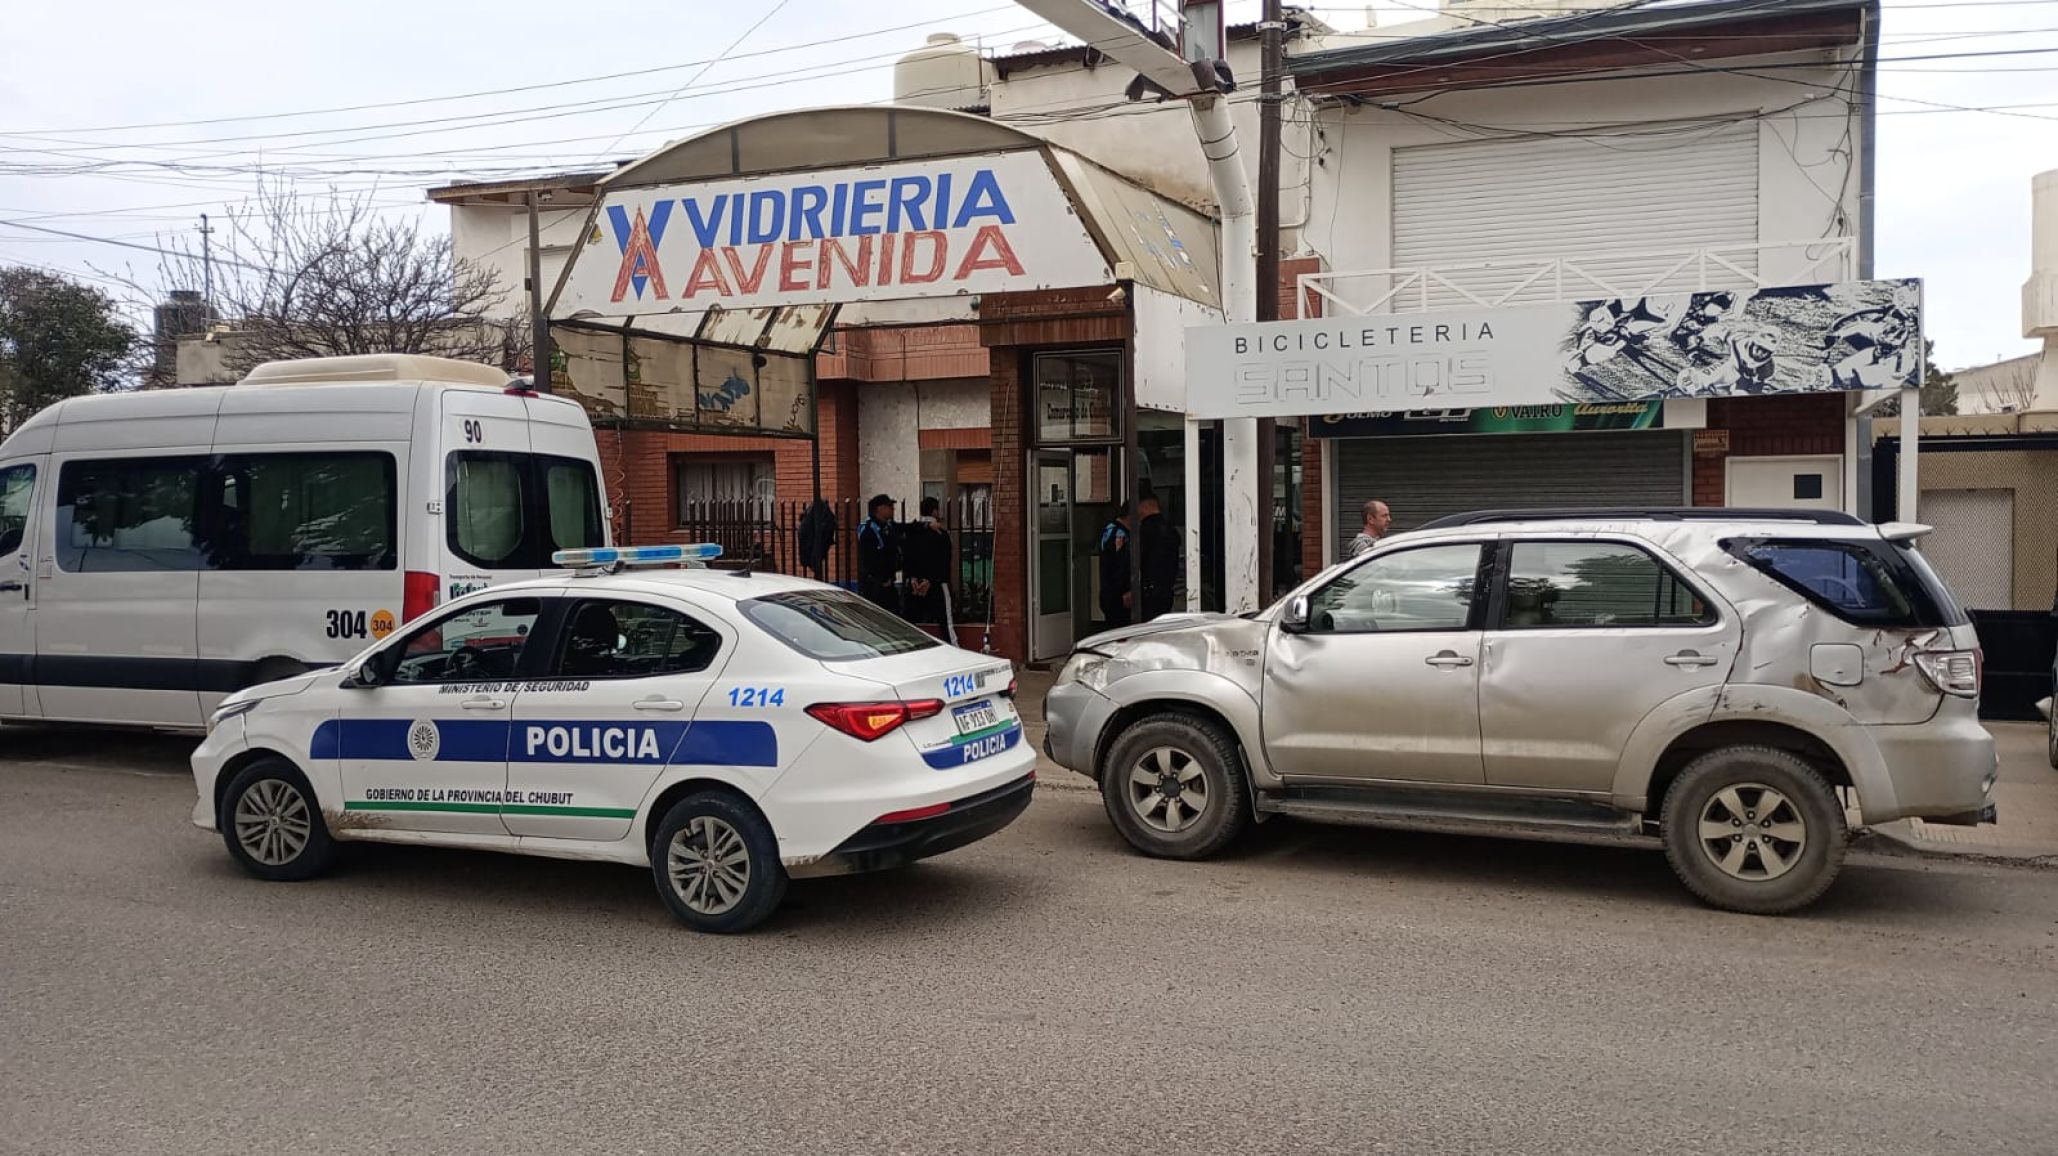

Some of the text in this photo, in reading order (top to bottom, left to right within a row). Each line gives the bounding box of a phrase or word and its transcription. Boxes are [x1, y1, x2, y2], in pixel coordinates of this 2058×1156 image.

[681, 169, 1016, 249] VIDRIERIA
[682, 225, 1027, 299] AVENIDA
[1235, 322, 1494, 354] BICICLETERIA
[1235, 350, 1494, 404] SANTOS
[464, 420, 482, 443] 90
[326, 609, 367, 639] 304
[373, 620, 393, 632] 304
[439, 681, 590, 694] MINISTERIO DE SEGURIDAD
[728, 687, 785, 707] 1214
[943, 673, 974, 698] 1214
[526, 726, 660, 759] POLICIA
[963, 733, 1006, 763] POLICIA
[366, 788, 574, 805] GOBIERNO DE LA PROVINCIA DEL CHUBUT
